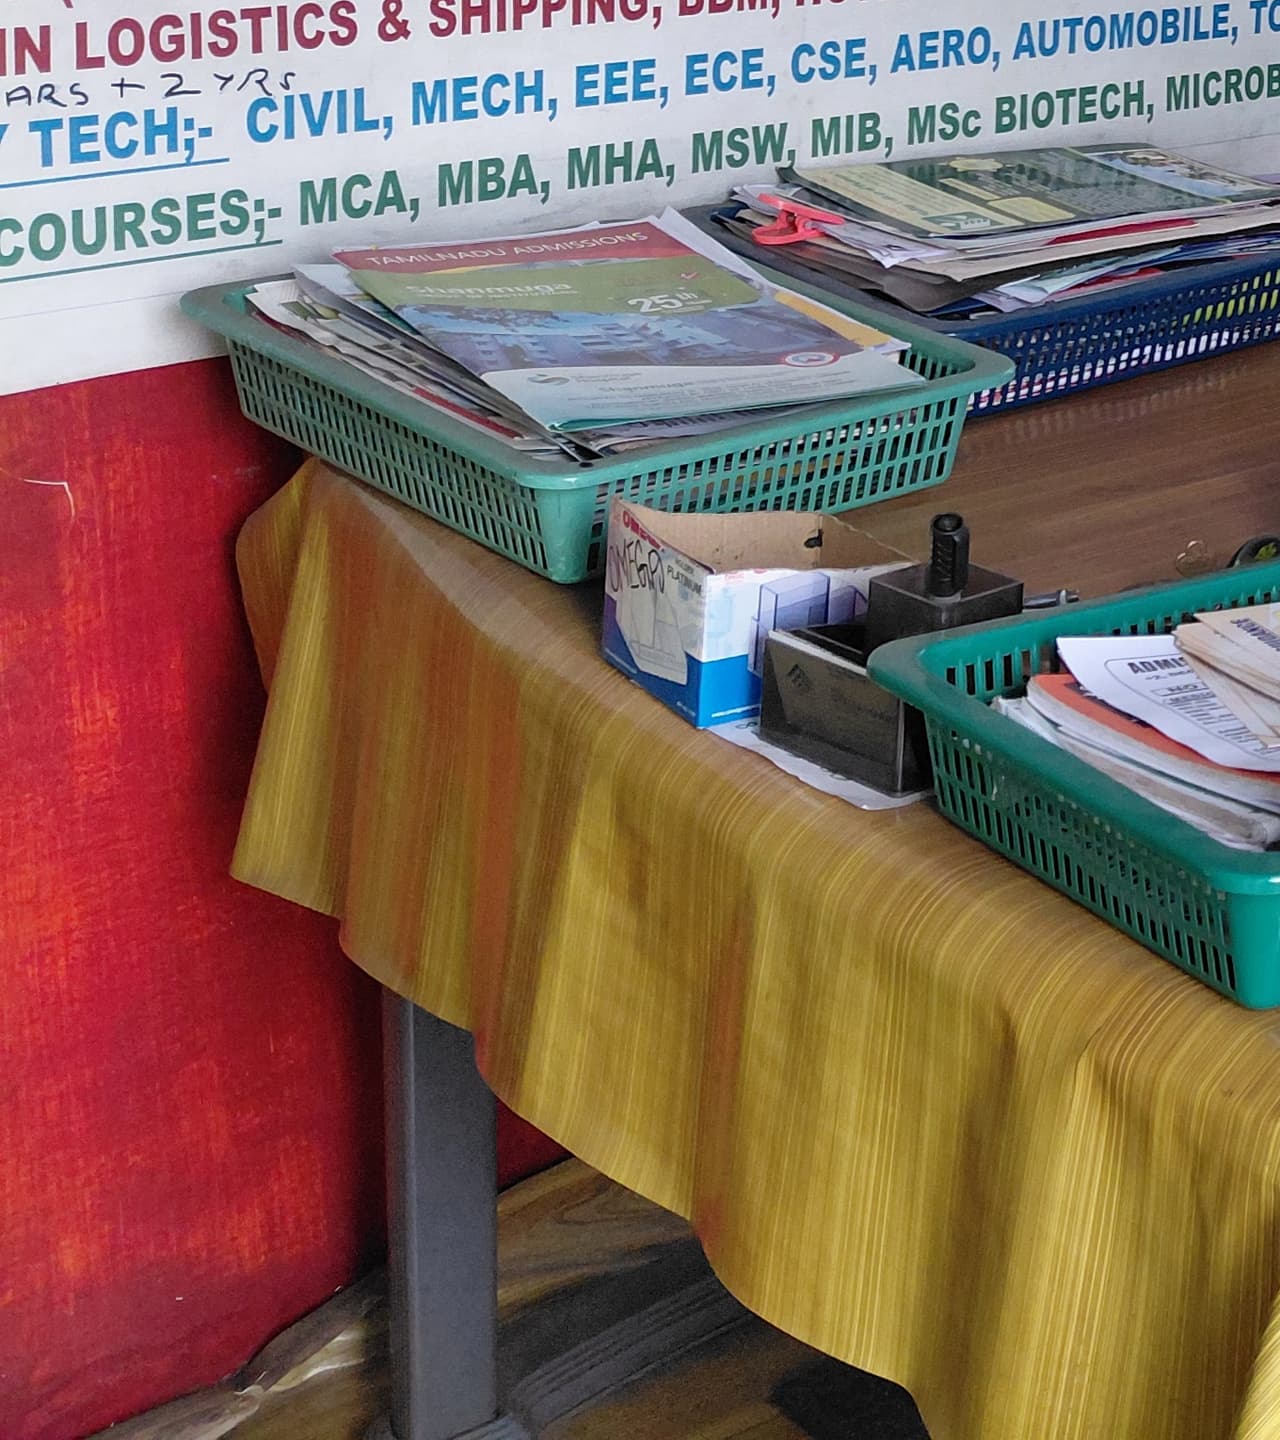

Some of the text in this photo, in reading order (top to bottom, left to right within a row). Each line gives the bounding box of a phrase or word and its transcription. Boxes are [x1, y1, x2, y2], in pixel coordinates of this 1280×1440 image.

[298, 169, 420, 226] MCA,
[437, 152, 550, 208] MBA,
[566, 137, 675, 190] MHA,
[690, 121, 796, 176] MSW,
[809, 110, 894, 159] MIB,
[906, 100, 982, 146] MSc
[993, 78, 1155, 135] BIOTECH,
[367, 230, 649, 267] TAMILNADU ADMISSIONS
